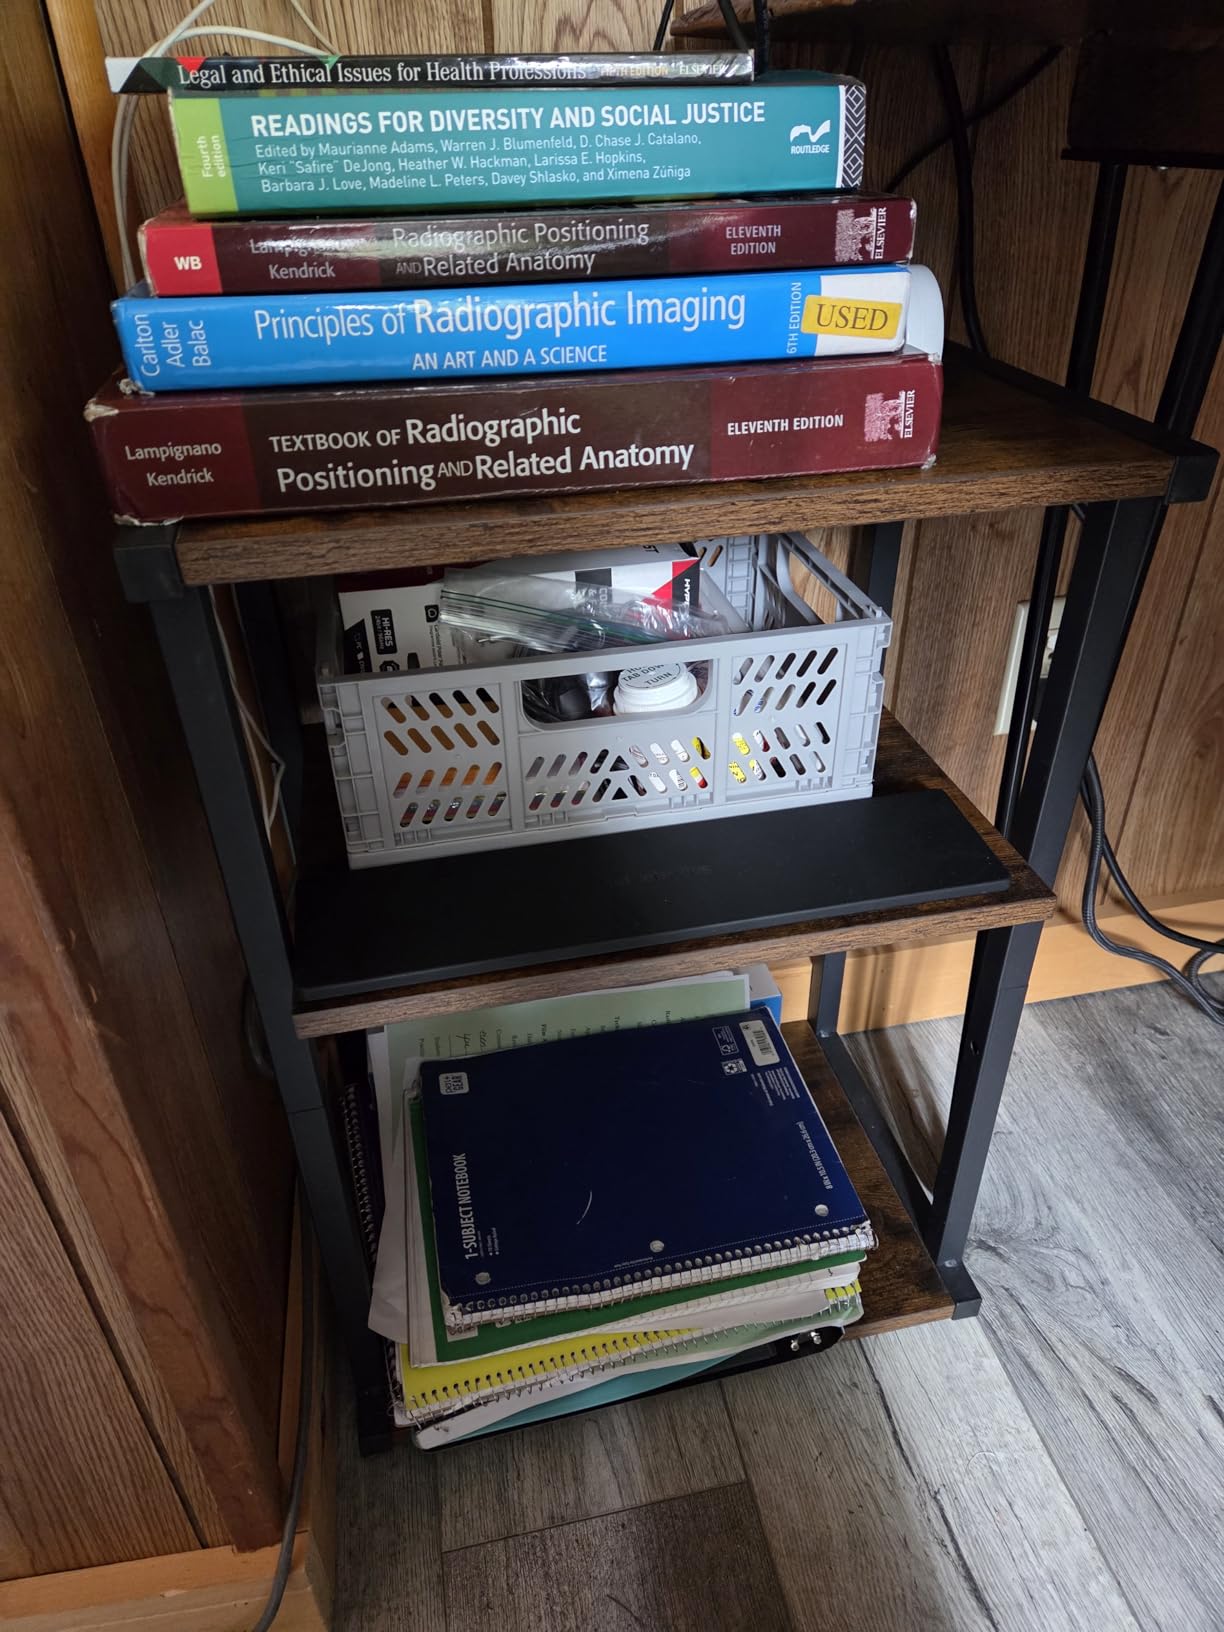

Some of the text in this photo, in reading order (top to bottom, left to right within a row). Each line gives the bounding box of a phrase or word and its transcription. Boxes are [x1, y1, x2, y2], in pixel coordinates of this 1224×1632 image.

[179, 61, 586, 89] Legal and Ethical Issues for Health Professions
[631, 64, 668, 76] EDITION
[251, 102, 765, 137] READINGS FOR DIVERSITY AND SOCIAL JUSTICE
[197, 135, 212, 178] Fourth
[211, 135, 226, 178] edition
[256, 132, 702, 160] Edited by Maurianne Adams, Warren J. Blumenfeld, D. Chase J. Catalano,
[790, 144, 830, 155] ROUTLEDGE
[258, 160, 288, 175] Keri
[344, 158, 396, 176] DeJong,
[399, 156, 448, 171] Heather
[450, 156, 467, 170] W.
[470, 154, 531, 169] Hackman,
[534, 152, 579, 166] Larissa
[582, 151, 592, 165] E.
[596, 150, 646, 166] Hopkins,
[261, 164, 691, 193] Barbara J. Love, Madeline L. Peters, Davey Shlasko, and Ximena Zúñiga
[392, 218, 649, 252] Radiographic Positioning
[726, 225, 781, 239] ELEVENTH
[875, 207, 887, 260] ELSEVIER
[174, 256, 202, 271] WB
[731, 242, 776, 256] EDITION
[269, 263, 336, 280] Kendrick
[396, 251, 596, 277] AND Related Anatomy
[254, 287, 746, 345] Principles of Radiographic Imaging
[786, 282, 802, 354] 6TH EDITION
[816, 302, 888, 332] USED
[134, 313, 160, 377] Carlton
[162, 321, 186, 368] Adler
[188, 320, 211, 367] Balac
[412, 345, 607, 371] AN ART AND A SCIENCE
[727, 414, 844, 436] ELEVENTH EDITION
[904, 390, 916, 438] ELSEVIER
[268, 407, 581, 453] TEXTBOOK OF Radiographic
[125, 442, 222, 461] Lampignano
[147, 468, 214, 488] Kendrick
[277, 443, 694, 492] Positioning AND Related Anatomy
[381, 617, 394, 647] HI-RES
[622, 673, 641, 682] TAB
[645, 672, 673, 685] TURN
[452, 1153, 479, 1260] 1-SUBJECT NOTEBOOK
